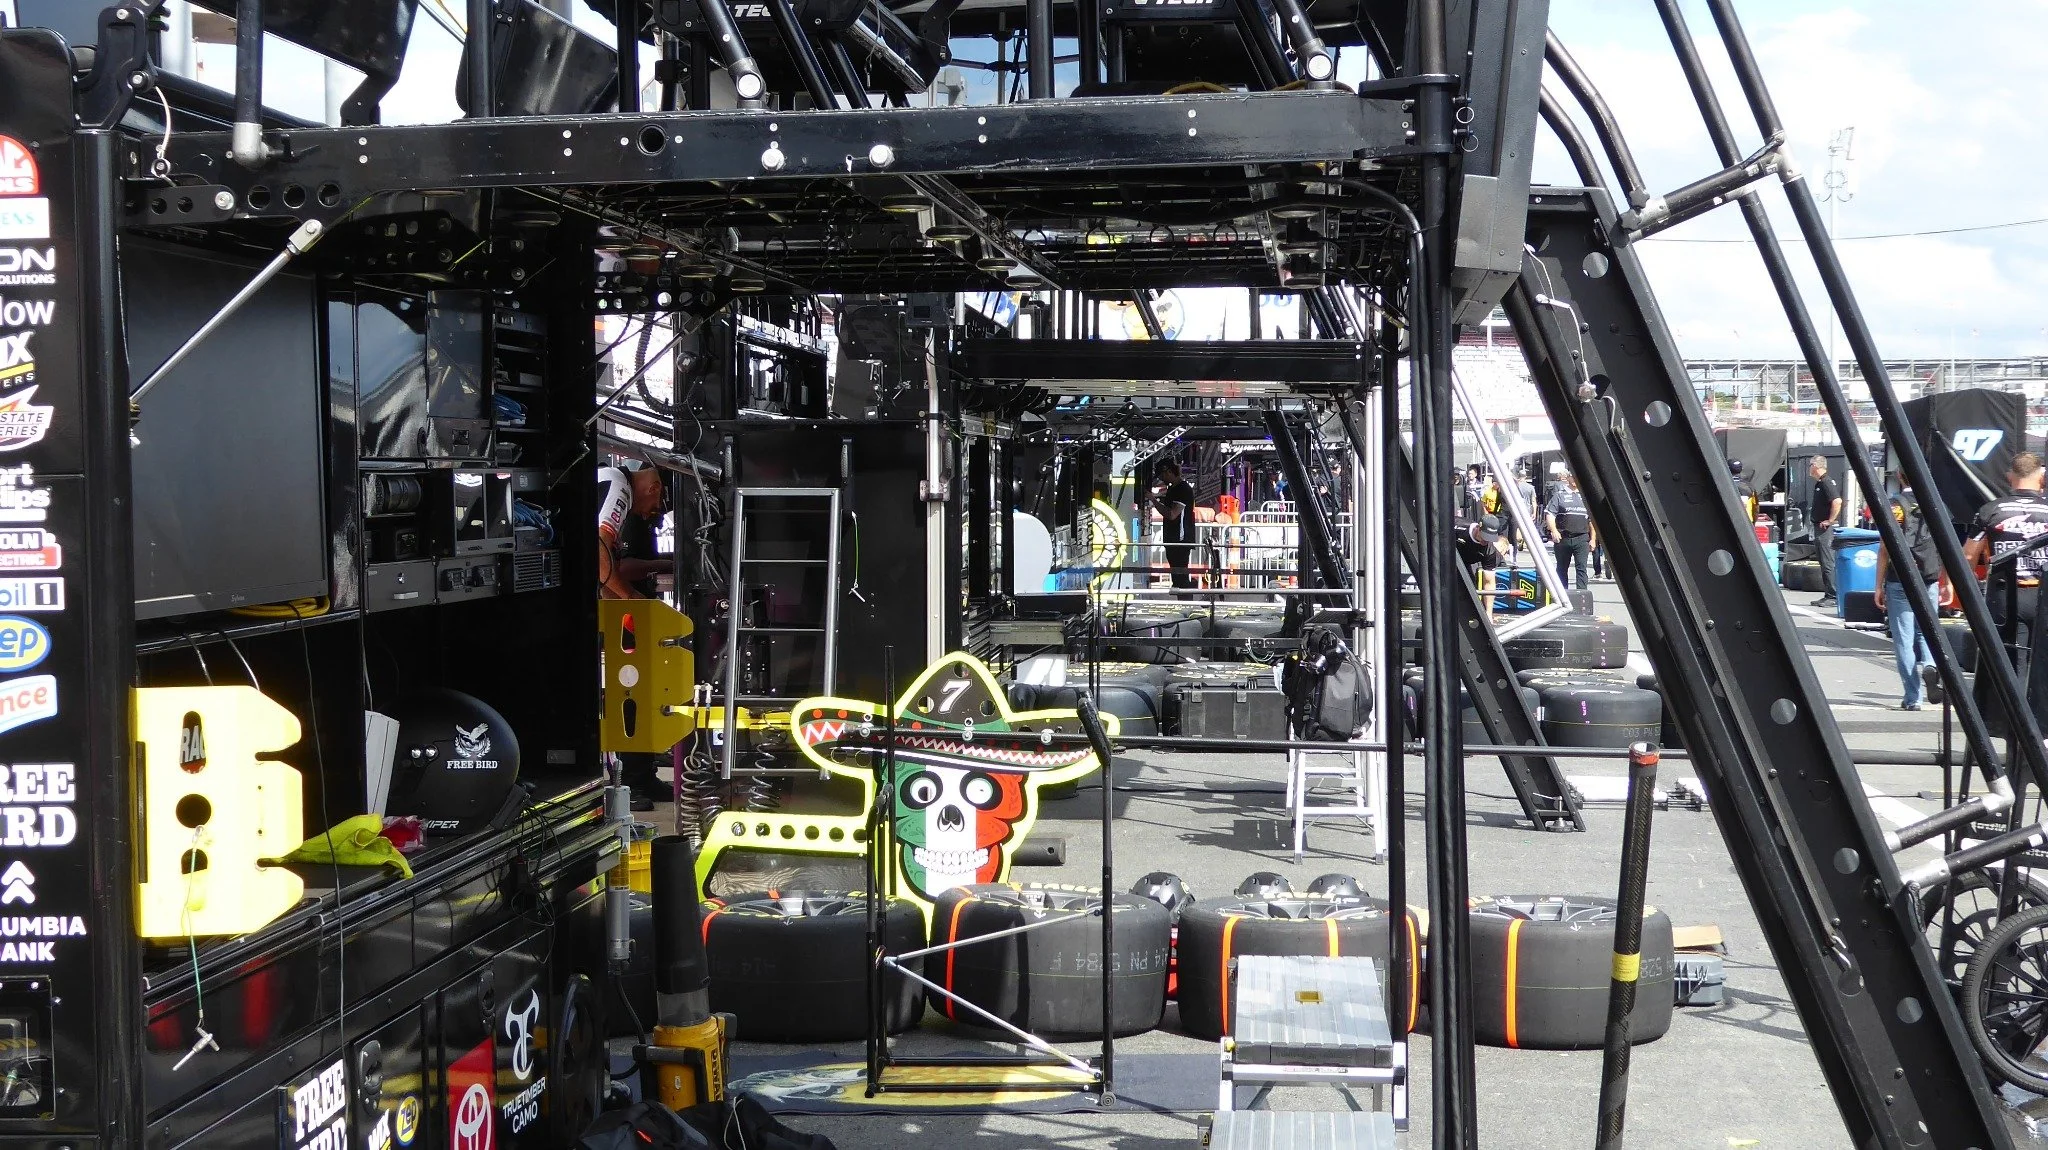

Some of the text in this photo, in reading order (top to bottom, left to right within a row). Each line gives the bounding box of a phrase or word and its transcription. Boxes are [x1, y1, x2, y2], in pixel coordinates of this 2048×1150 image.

[0, 412, 44, 423] STATE
[1953, 429, 2003, 461] 97
[0, 553, 46, 567] CTRIC
[39, 583, 51, 605] 1
[937, 678, 973, 715] 7
[446, 760, 498, 769] FREE BIRD
[0, 806, 77, 847] RD
[0, 916, 87, 937] UMBIA
[293, 1058, 347, 1143] FREE
[502, 1076, 547, 1120] TRUETIMBER
[512, 1101, 538, 1134] CAMO
